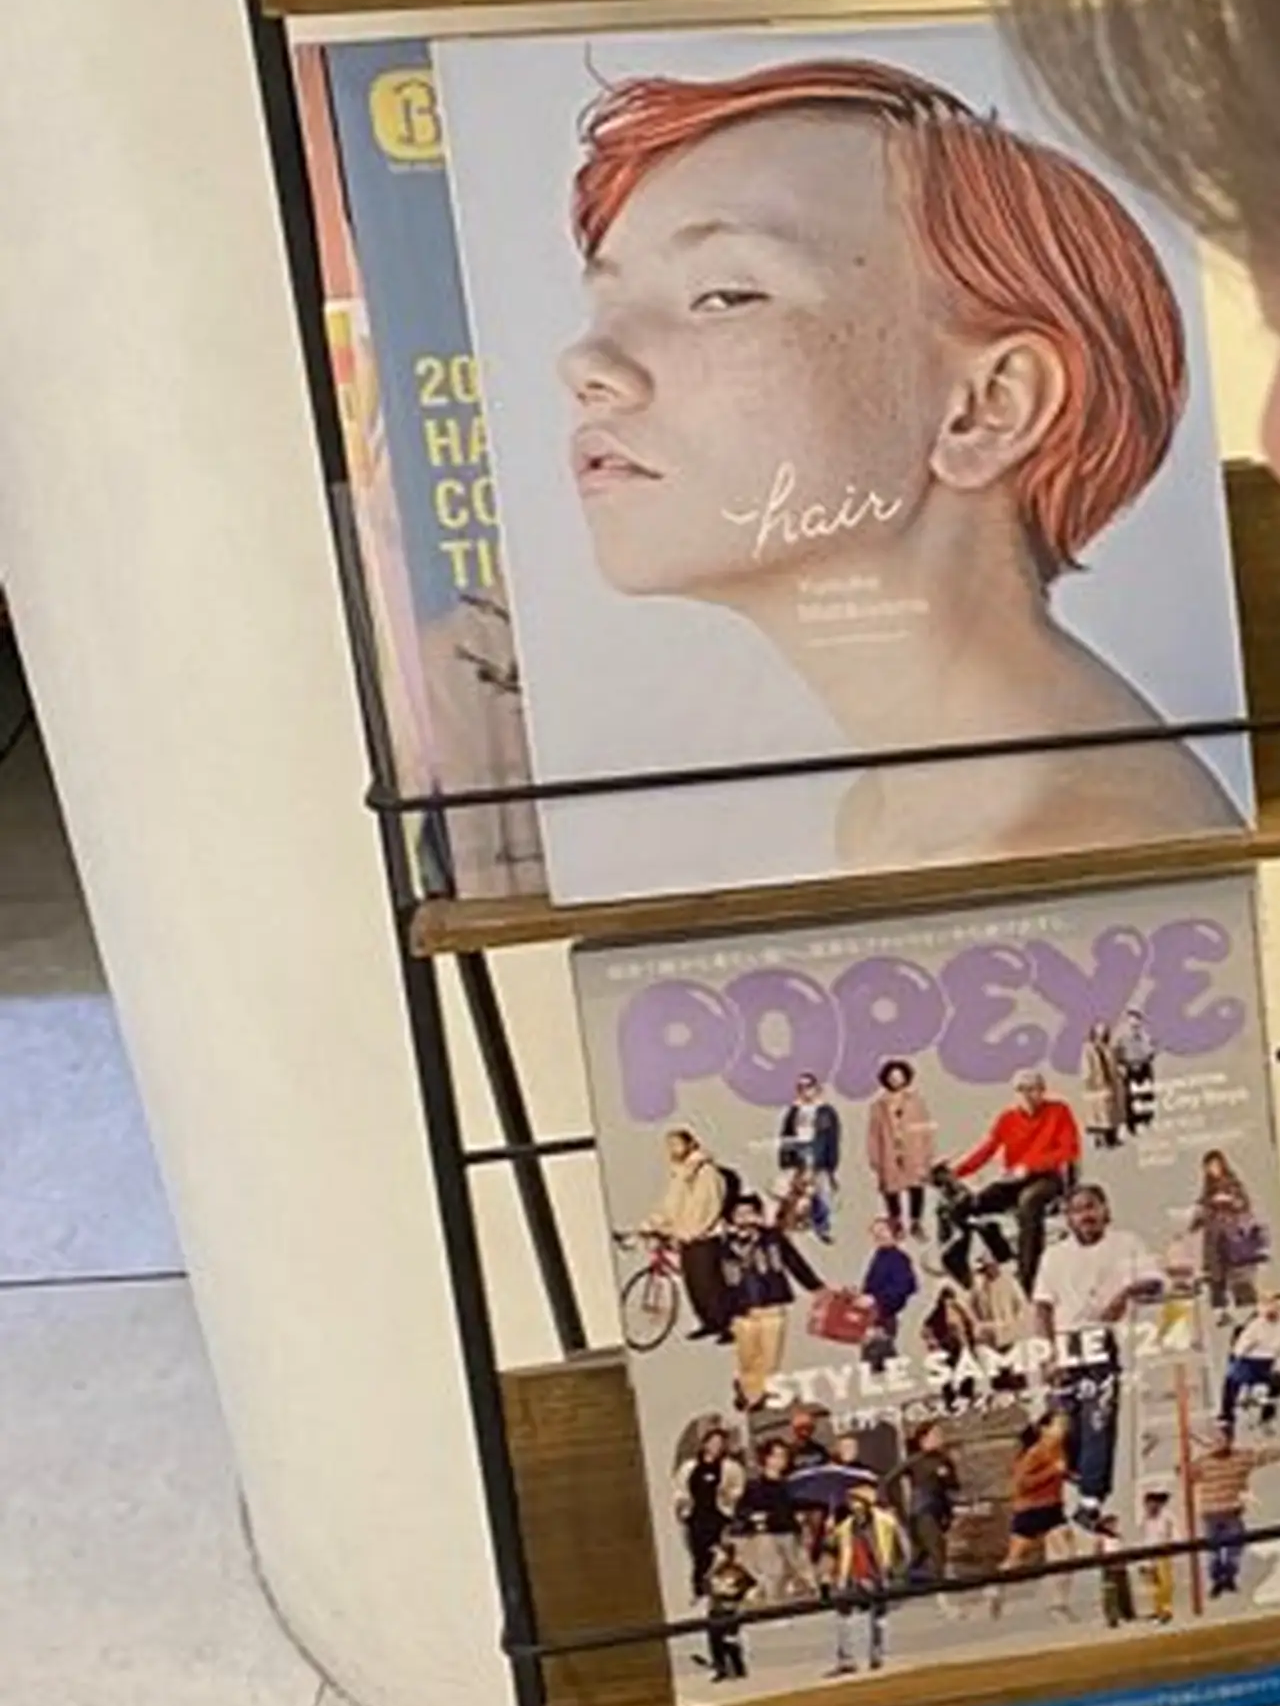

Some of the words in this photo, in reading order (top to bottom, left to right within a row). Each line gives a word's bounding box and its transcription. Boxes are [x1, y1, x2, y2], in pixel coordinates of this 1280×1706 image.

[752, 460, 902, 559] hair
[617, 918, 1246, 1122] POPEYE
[763, 1353, 912, 1410] STYLE
[923, 1328, 1109, 1391] SAMPLE
